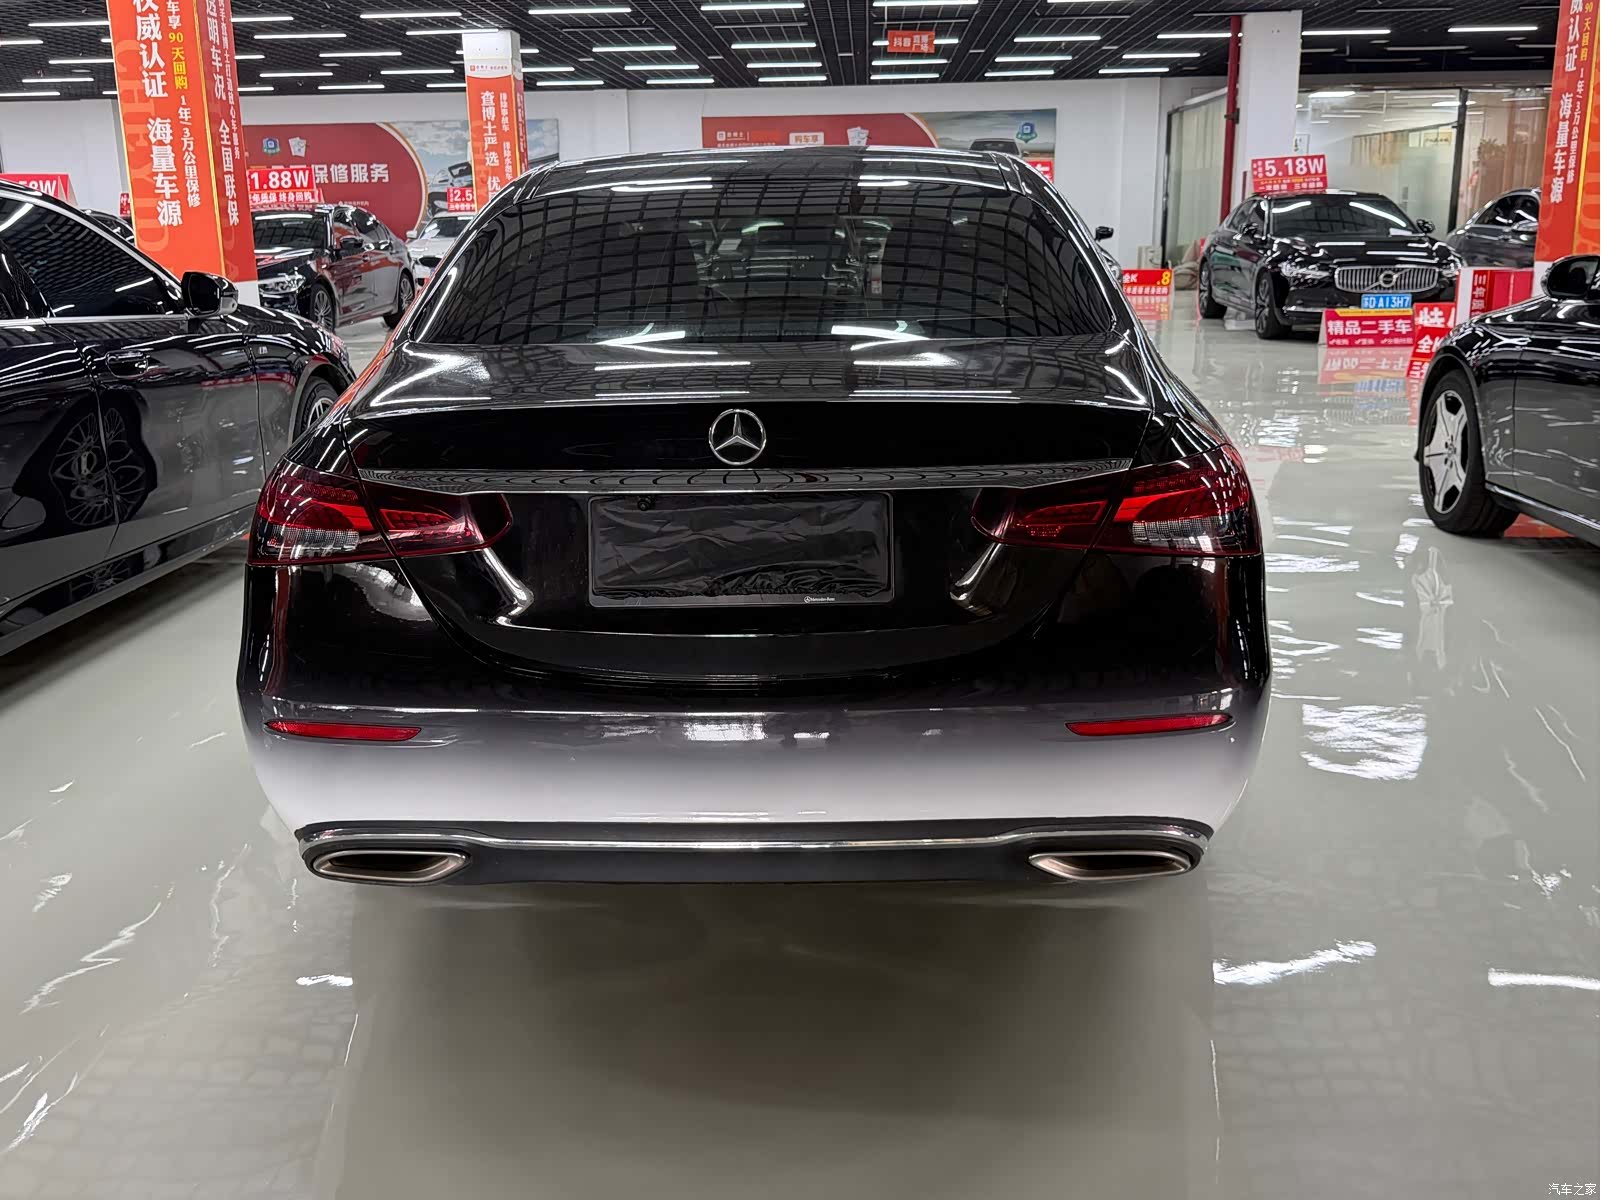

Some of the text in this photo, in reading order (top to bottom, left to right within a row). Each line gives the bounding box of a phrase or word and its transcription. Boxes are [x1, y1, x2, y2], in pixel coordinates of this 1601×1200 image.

[480, 91, 499, 167] 查博士严选
[1550, 92, 1573, 203] 海量车源
[147, 117, 182, 226] 海量车源
[219, 118, 239, 226] 全国联保
[311, 163, 390, 184] 保修服务
[1265, 158, 1324, 177] 5.18W
[250, 170, 309, 190] 1.88W
[453, 189, 475, 202] 2.5
[1327, 318, 1413, 335] 精品二手车
[1414, 306, 1456, 329] 特
